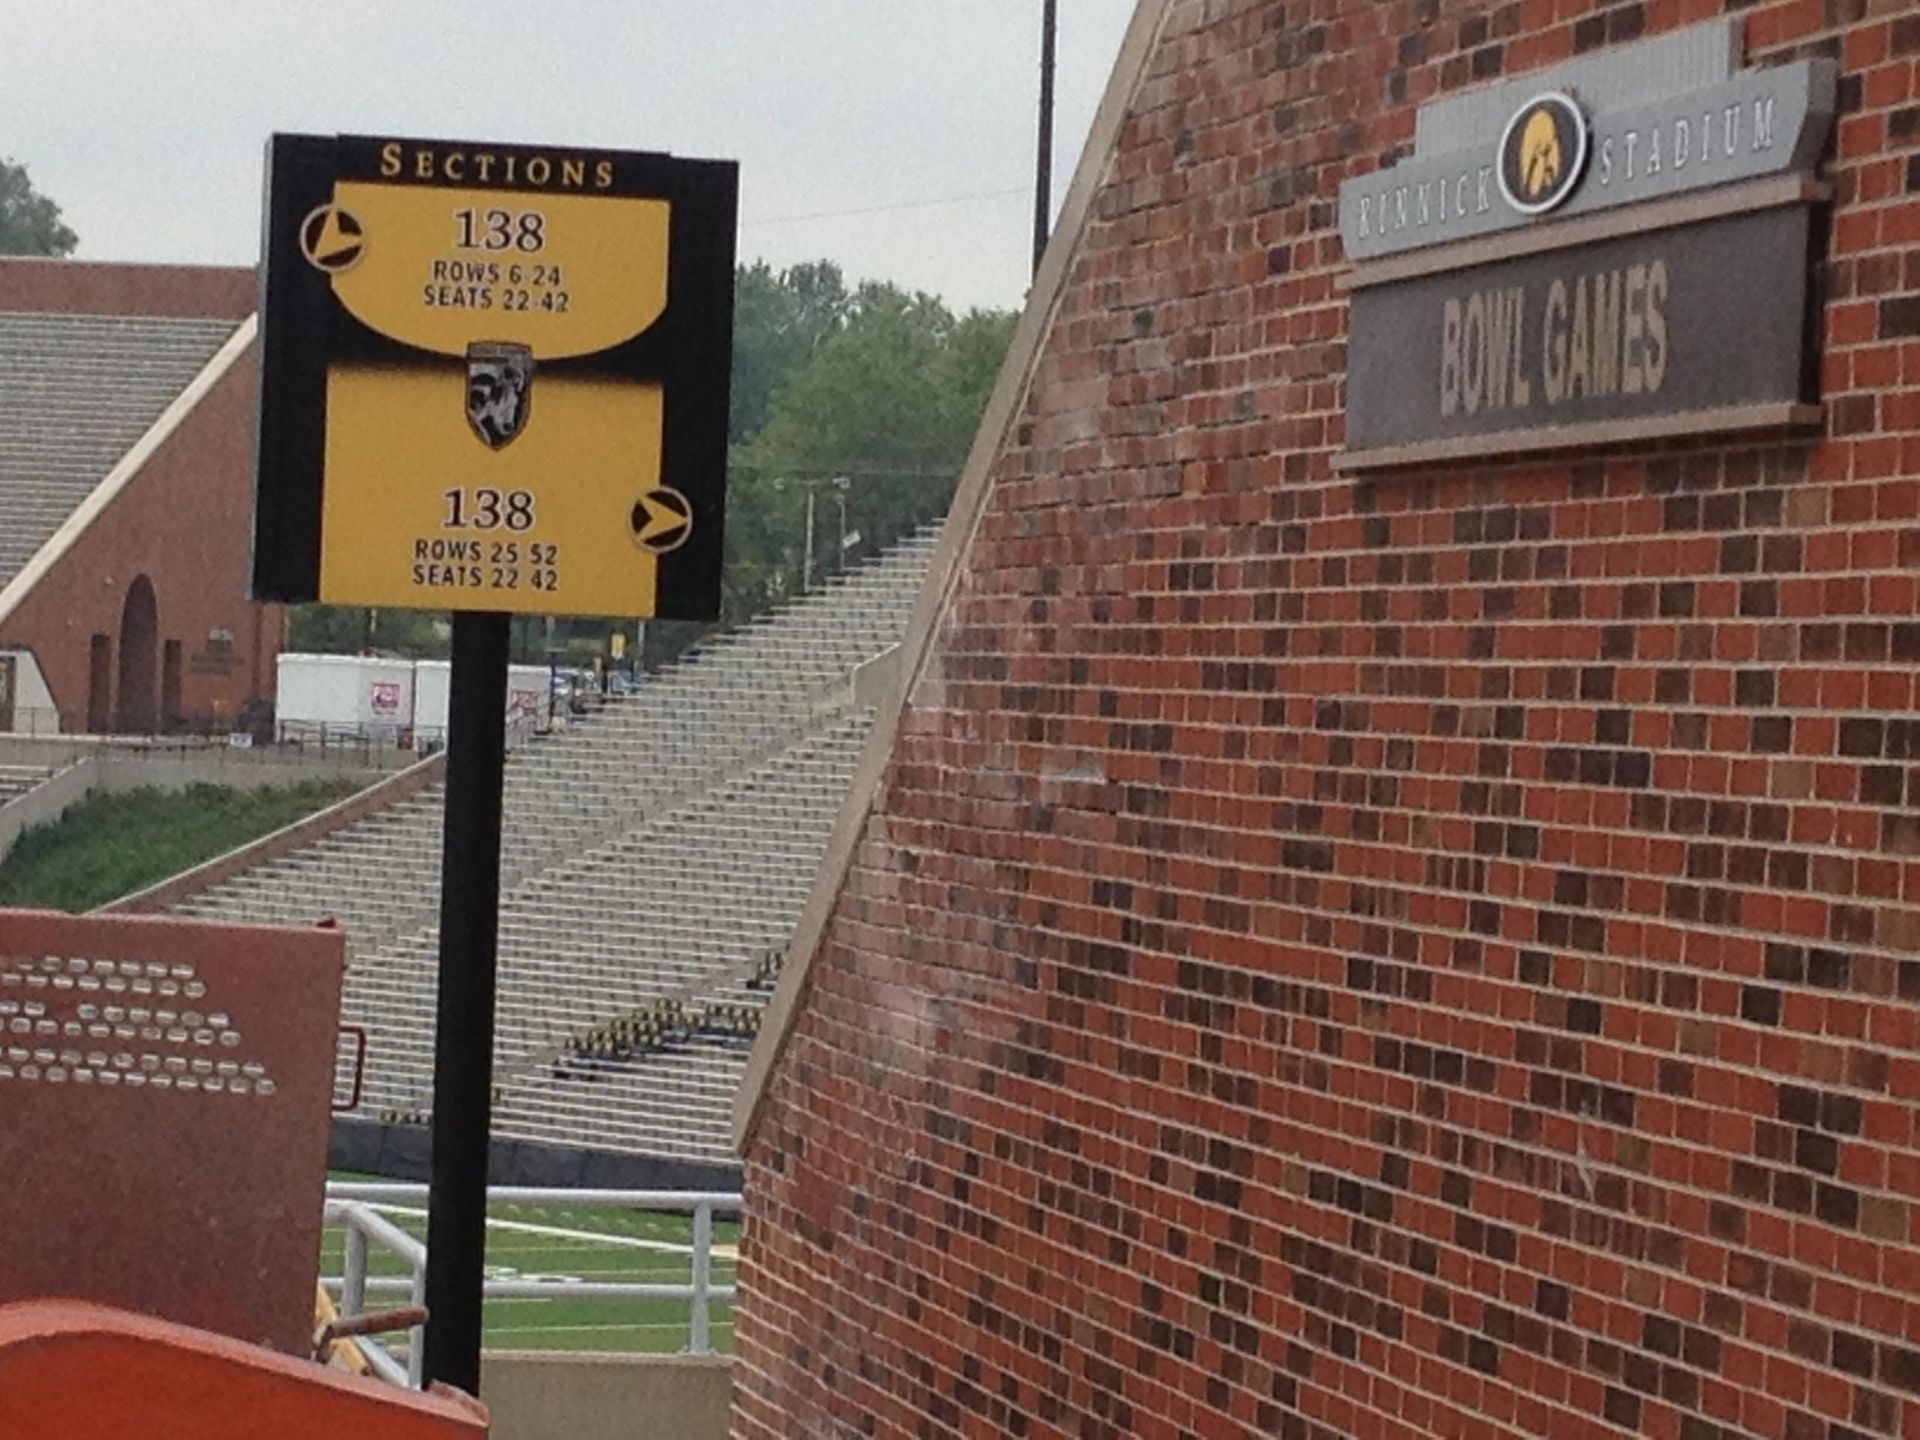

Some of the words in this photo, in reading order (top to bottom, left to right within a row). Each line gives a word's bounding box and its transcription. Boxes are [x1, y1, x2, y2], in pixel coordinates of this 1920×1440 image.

[1601, 97, 1775, 185] STADIUM
[381, 143, 613, 187] SECTIONS
[454, 207, 545, 253] 138
[433, 260, 500, 284] ROWS
[423, 284, 493, 309] SEATS
[1440, 286, 1530, 417] BOWL
[1542, 260, 1668, 404] GAMES
[443, 488, 535, 531] 138
[414, 538, 482, 562] ROWS
[412, 564, 483, 588] SEATS
